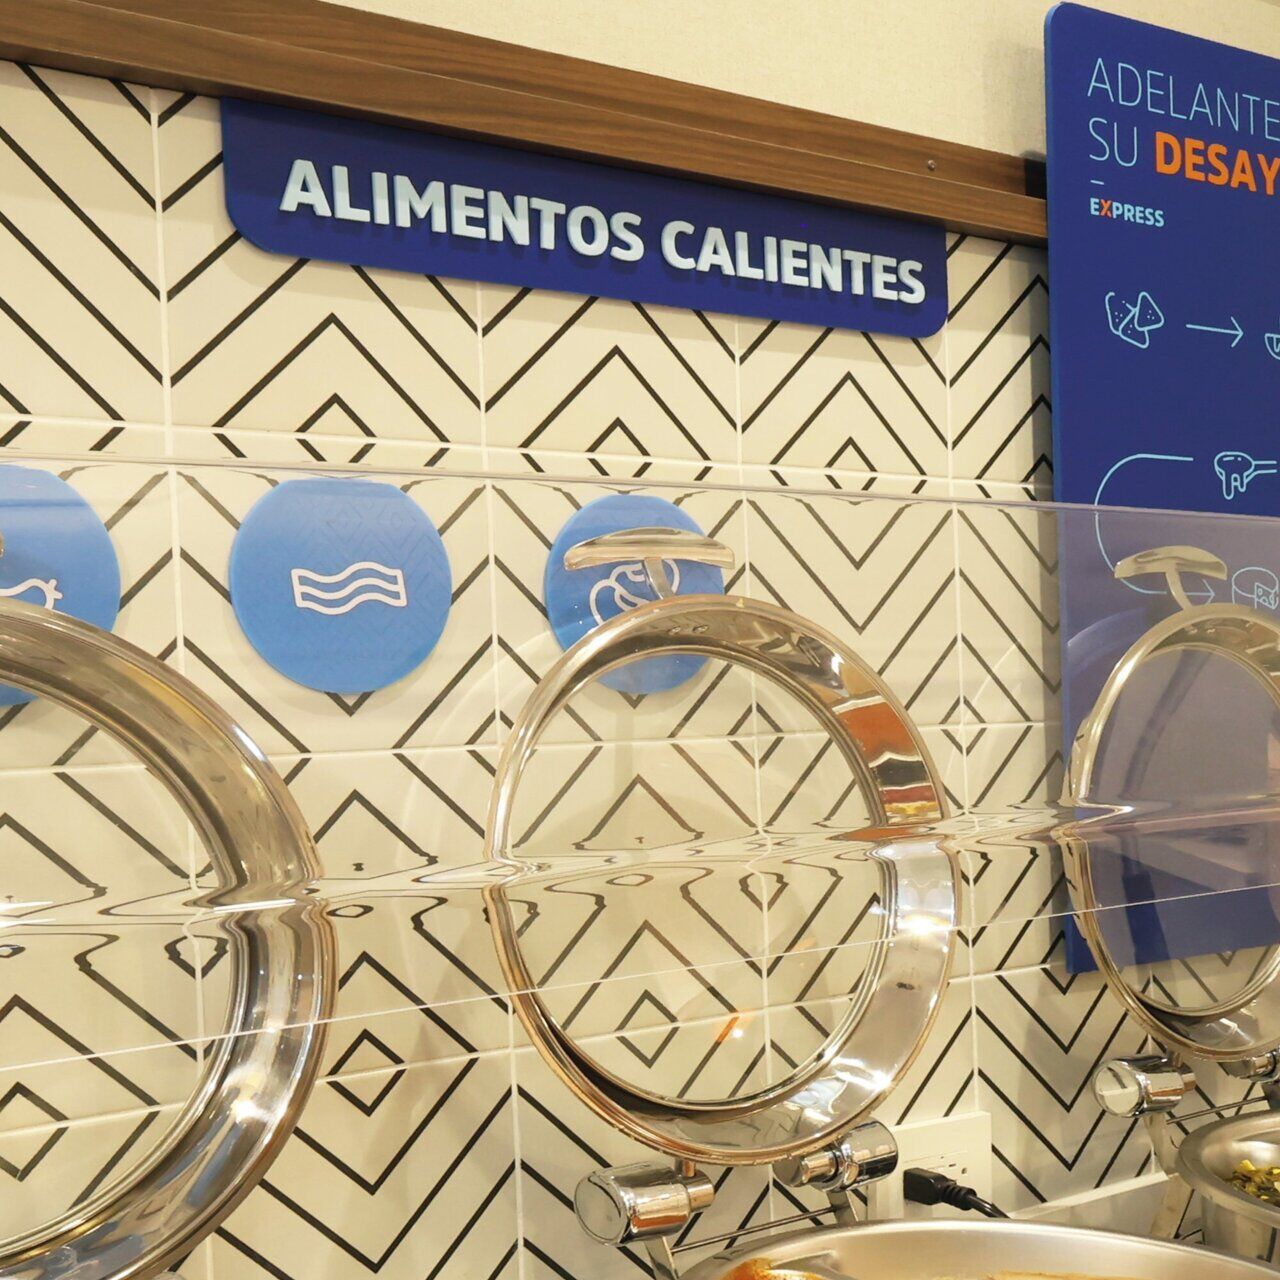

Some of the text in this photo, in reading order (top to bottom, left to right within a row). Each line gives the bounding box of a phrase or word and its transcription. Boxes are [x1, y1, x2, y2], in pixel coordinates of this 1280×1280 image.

[1088, 117, 1138, 167] SU
[279, 158, 926, 304] ALIMENTOS CALIENTES
[1089, 197, 1165, 228] EXPRESS
